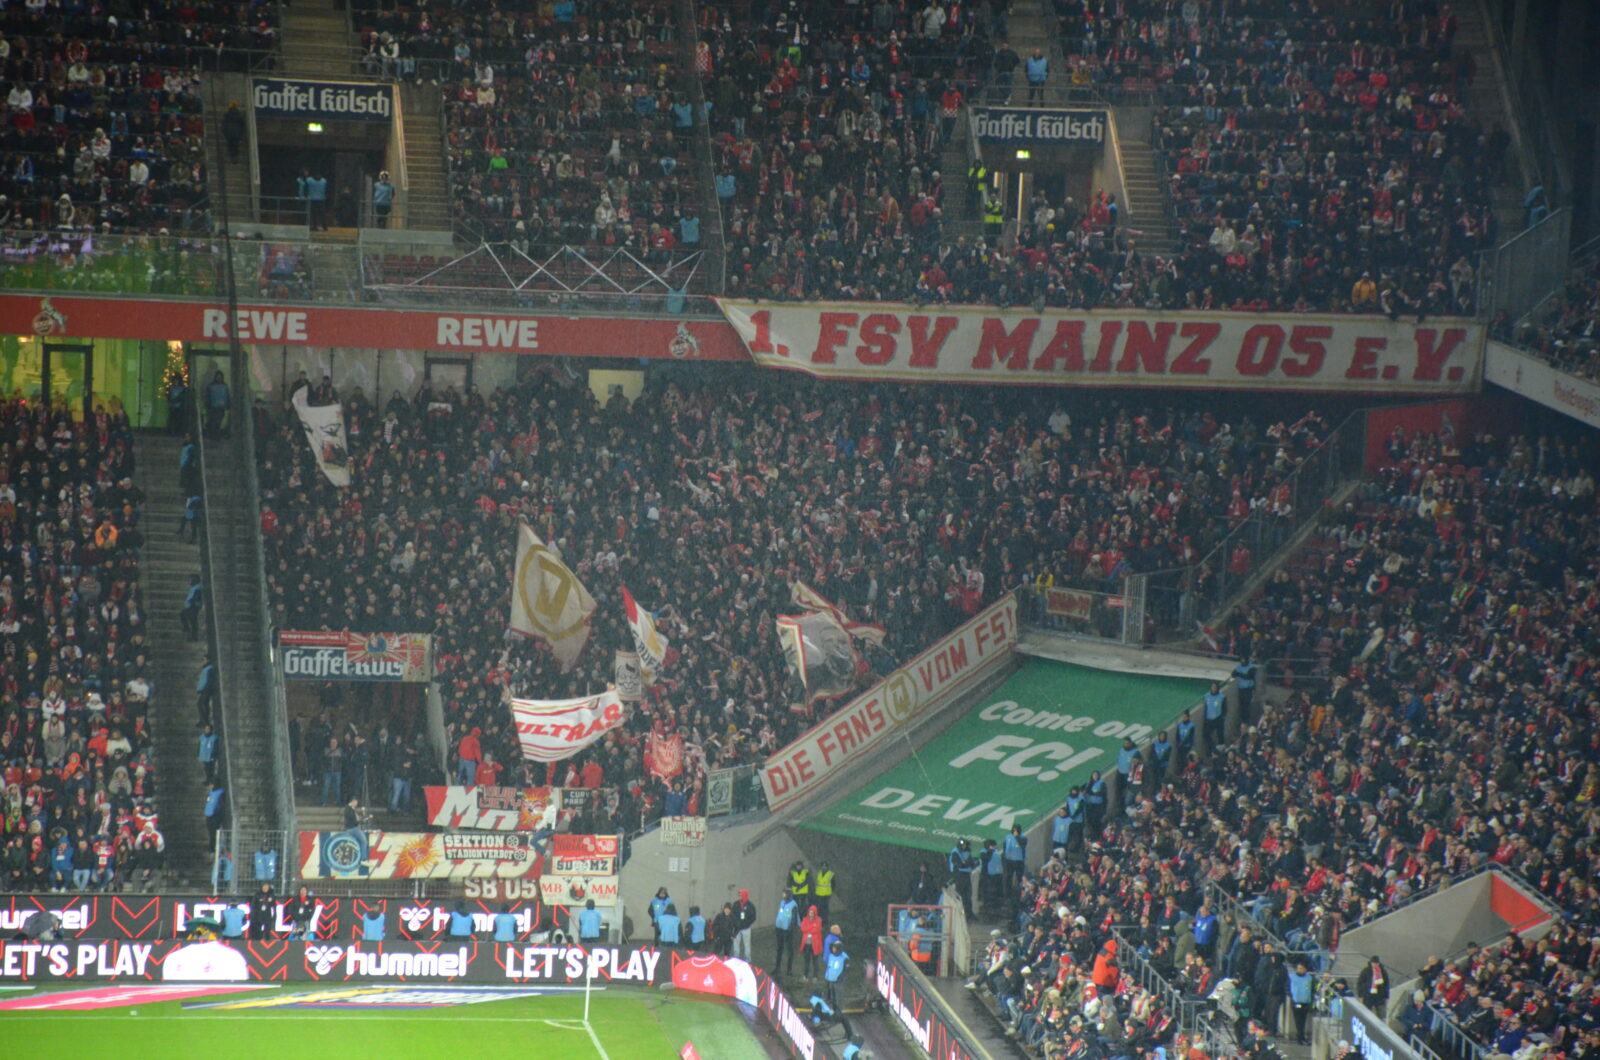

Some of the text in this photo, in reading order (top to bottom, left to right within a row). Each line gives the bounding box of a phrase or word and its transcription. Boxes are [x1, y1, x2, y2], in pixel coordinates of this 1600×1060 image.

[255, 83, 390, 117] Gaffel Kölsch
[975, 113, 1103, 142] Gaffel Kölsch
[203, 308, 308, 340] REWE
[437, 317, 538, 348] REWE
[811, 312, 959, 368] FSV
[971, 317, 1221, 374] MAINZ
[1235, 324, 1334, 378] 05
[285, 649, 349, 676] Gaffel
[515, 704, 624, 742] ULTRAS
[767, 750, 816, 797] DIE
[816, 699, 887, 766] FANS
[919, 638, 969, 693] VOM
[979, 700, 1095, 733] Come
[949, 735, 1104, 782] FC!
[859, 787, 1037, 830] DEVK
[445, 834, 504, 848] SEKTION
[591, 884, 617, 895] MM
[0, 944, 152, 976] ET'S PLAY
[346, 945, 468, 977] hummel
[506, 947, 660, 980] LET'S PLAY
